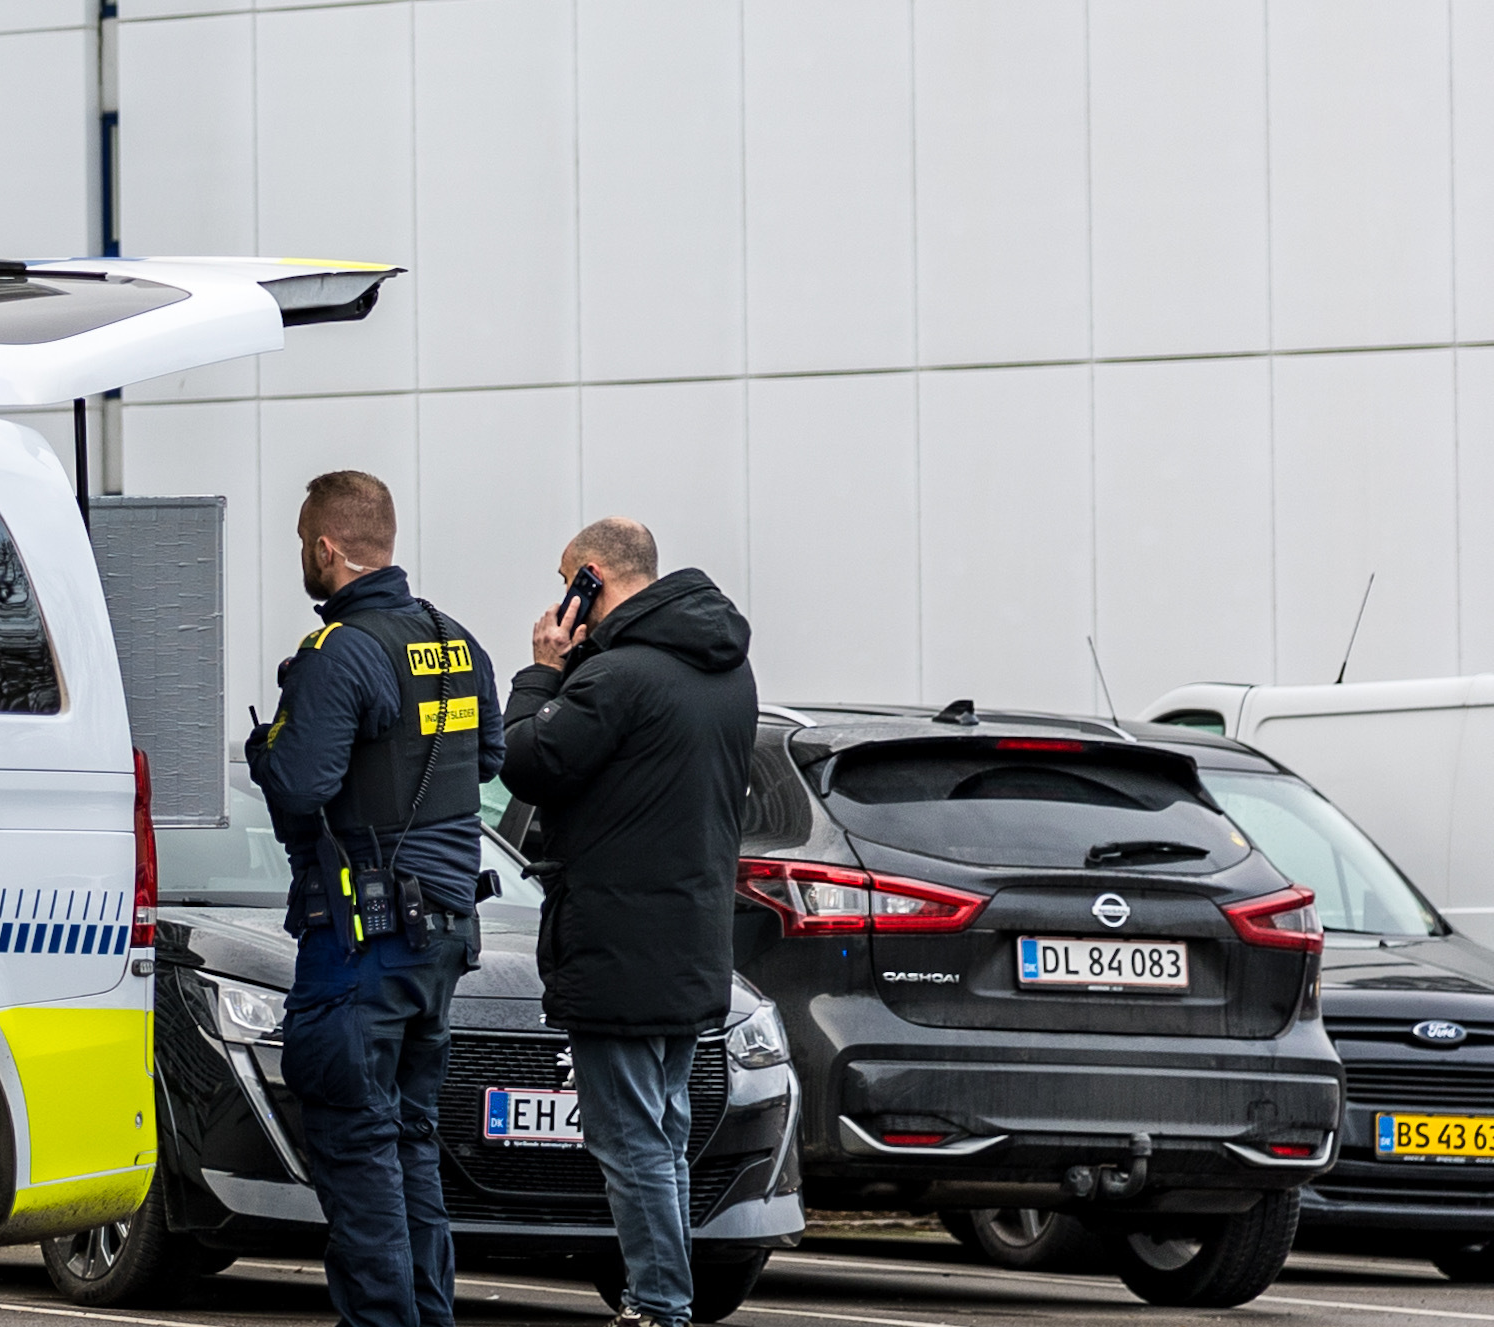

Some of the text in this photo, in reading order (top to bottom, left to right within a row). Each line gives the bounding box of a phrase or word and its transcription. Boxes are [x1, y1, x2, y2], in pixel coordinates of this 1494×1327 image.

[409, 645, 470, 671] POLTI
[425, 708, 475, 723] INDTSLEDER
[1042, 946, 1080, 975] DL
[1089, 947, 1122, 977] 84
[1131, 948, 1181, 978] 083
[882, 972, 960, 984] QASHQAI
[1427, 1023, 1457, 1038] Ford
[490, 1099, 582, 1133] DK EH 4
[1397, 1122, 1430, 1148] BS
[1438, 1124, 1466, 1149] 43
